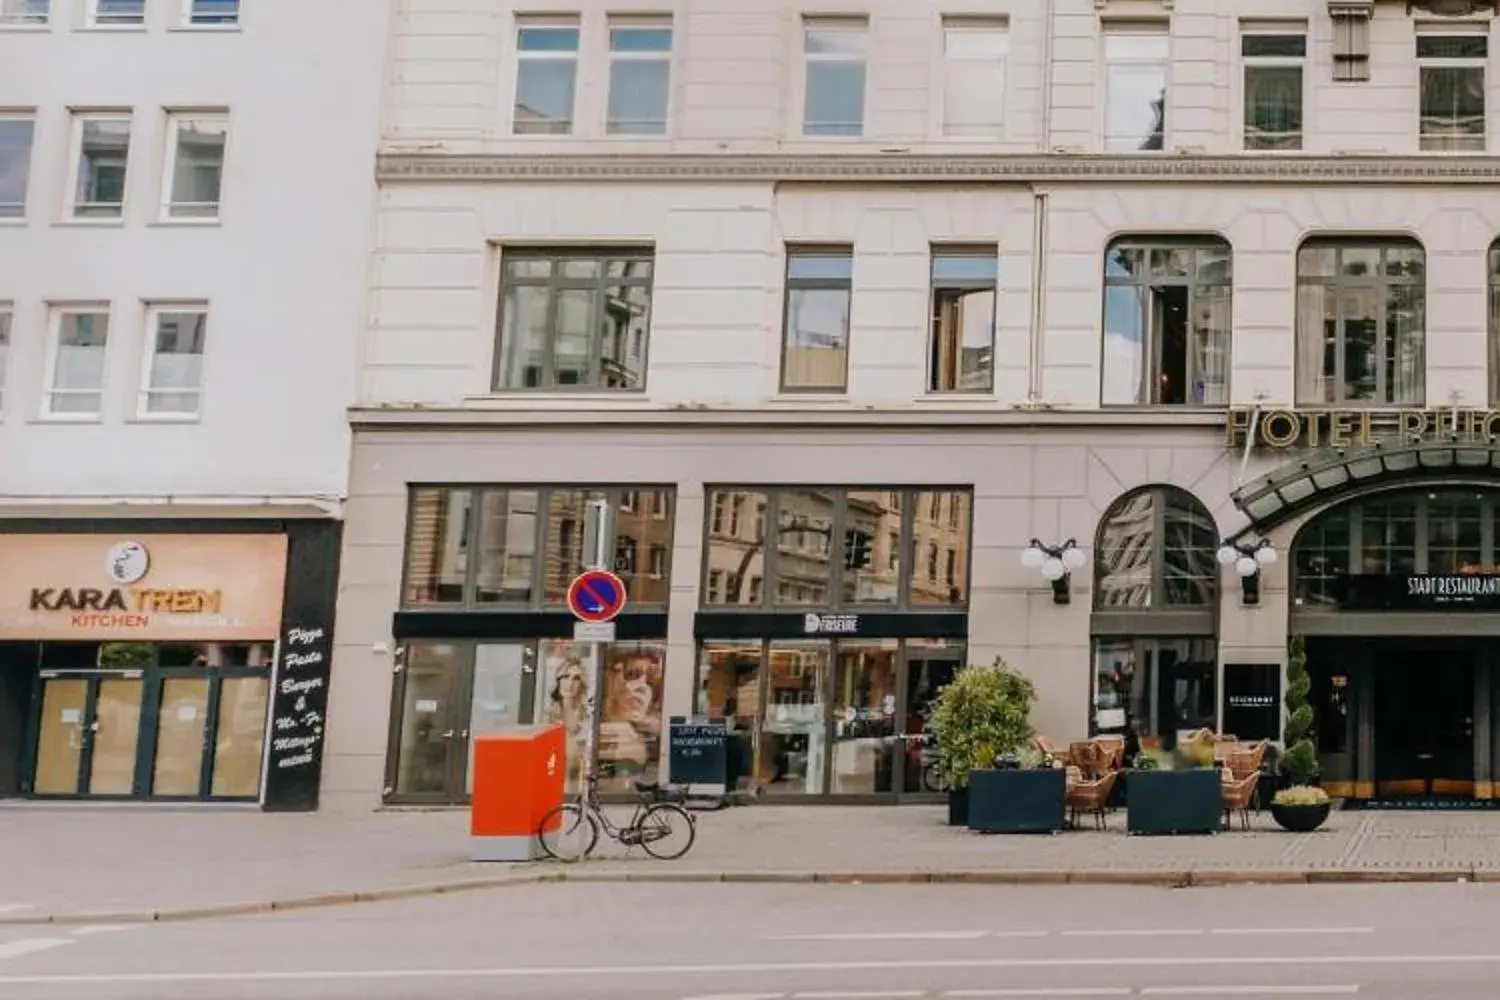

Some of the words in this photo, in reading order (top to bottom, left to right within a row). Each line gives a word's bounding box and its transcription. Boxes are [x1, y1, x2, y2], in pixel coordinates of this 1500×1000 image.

[1226, 409, 1378, 447] HOTEL
[1438, 577, 1500, 595] RESTAURANT
[29, 588, 127, 611] KARA
[71, 614, 149, 627] KITCHEN
[287, 627, 324, 644] Pizza
[285, 651, 323, 669] Pasta
[281, 677, 323, 694] Burger
